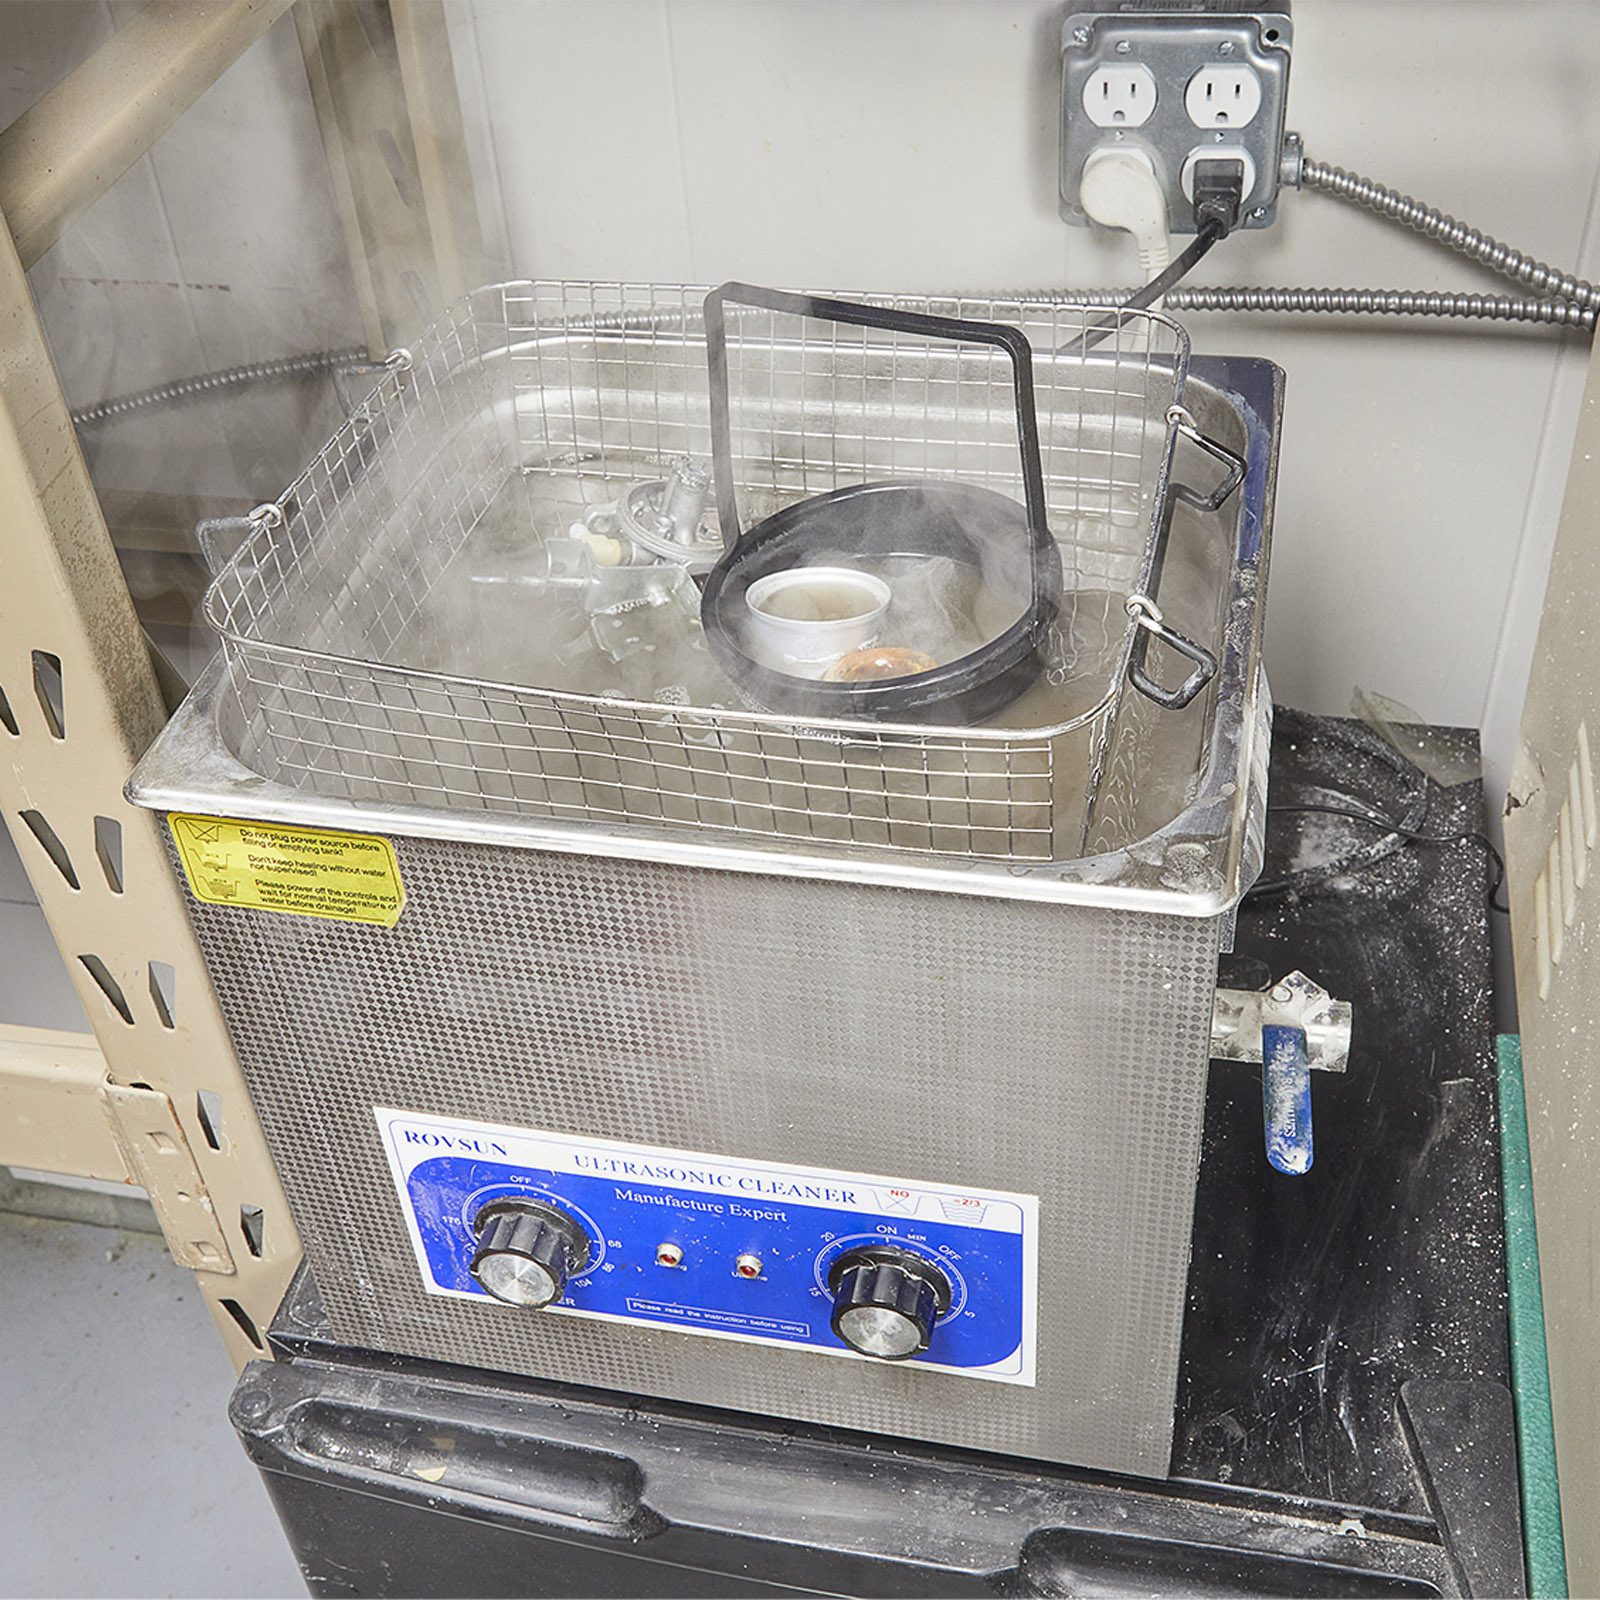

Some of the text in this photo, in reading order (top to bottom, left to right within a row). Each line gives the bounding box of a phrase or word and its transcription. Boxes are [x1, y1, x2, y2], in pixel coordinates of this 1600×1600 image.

[239, 828, 380, 852] Do not plug power source before
[278, 844, 320, 855] emptying
[248, 854, 272, 864] Don't
[272, 857, 295, 868] keep
[328, 864, 362, 876] without
[362, 869, 386, 878] water
[254, 878, 286, 890] Please
[286, 884, 313, 893] power
[326, 888, 342, 896] the
[343, 890, 378, 900] controls
[379, 895, 397, 903] and
[258, 888, 278, 897] wait
[278, 890, 292, 898] for
[293, 892, 326, 902] normal
[328, 896, 387, 910] temperature
[260, 897, 284, 905] water
[285, 898, 314, 908] before
[403, 1130, 507, 1156] ROVSUN
[510, 1174, 532, 1184] OFF
[574, 1154, 857, 1205] ULTRASONIC CLEANER
[890, 1188, 910, 1199] NO
[614, 1186, 788, 1222] Manufacture Expert
[876, 1224, 898, 1235] ON
[820, 1231, 835, 1243] 20
[907, 1233, 927, 1242] MIN
[938, 1244, 962, 1262] OFF
[574, 1278, 593, 1288] 104
[808, 1286, 822, 1298] 15
[632, 1302, 662, 1312] Please
[665, 1306, 684, 1316] read
[704, 1312, 747, 1324] instruction
[750, 1320, 778, 1329] before
[780, 1324, 804, 1334] using
[964, 1310, 976, 1320] 5
